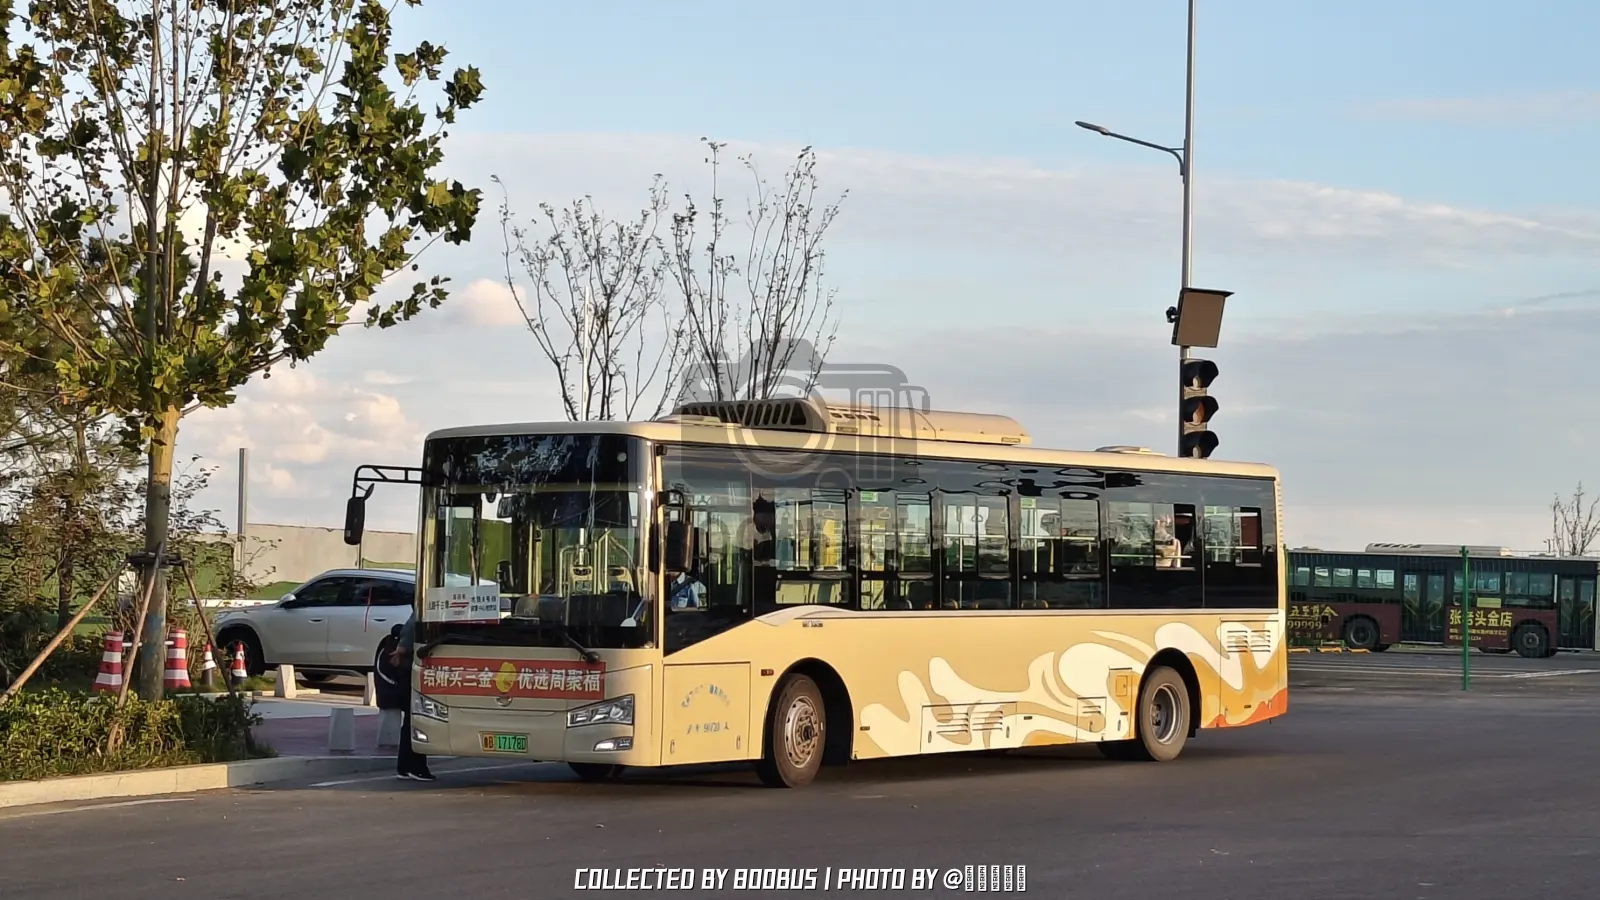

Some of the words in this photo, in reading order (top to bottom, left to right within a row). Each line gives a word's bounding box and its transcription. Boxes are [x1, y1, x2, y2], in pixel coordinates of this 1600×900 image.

[517, 666, 601, 692] 优选周聚福
